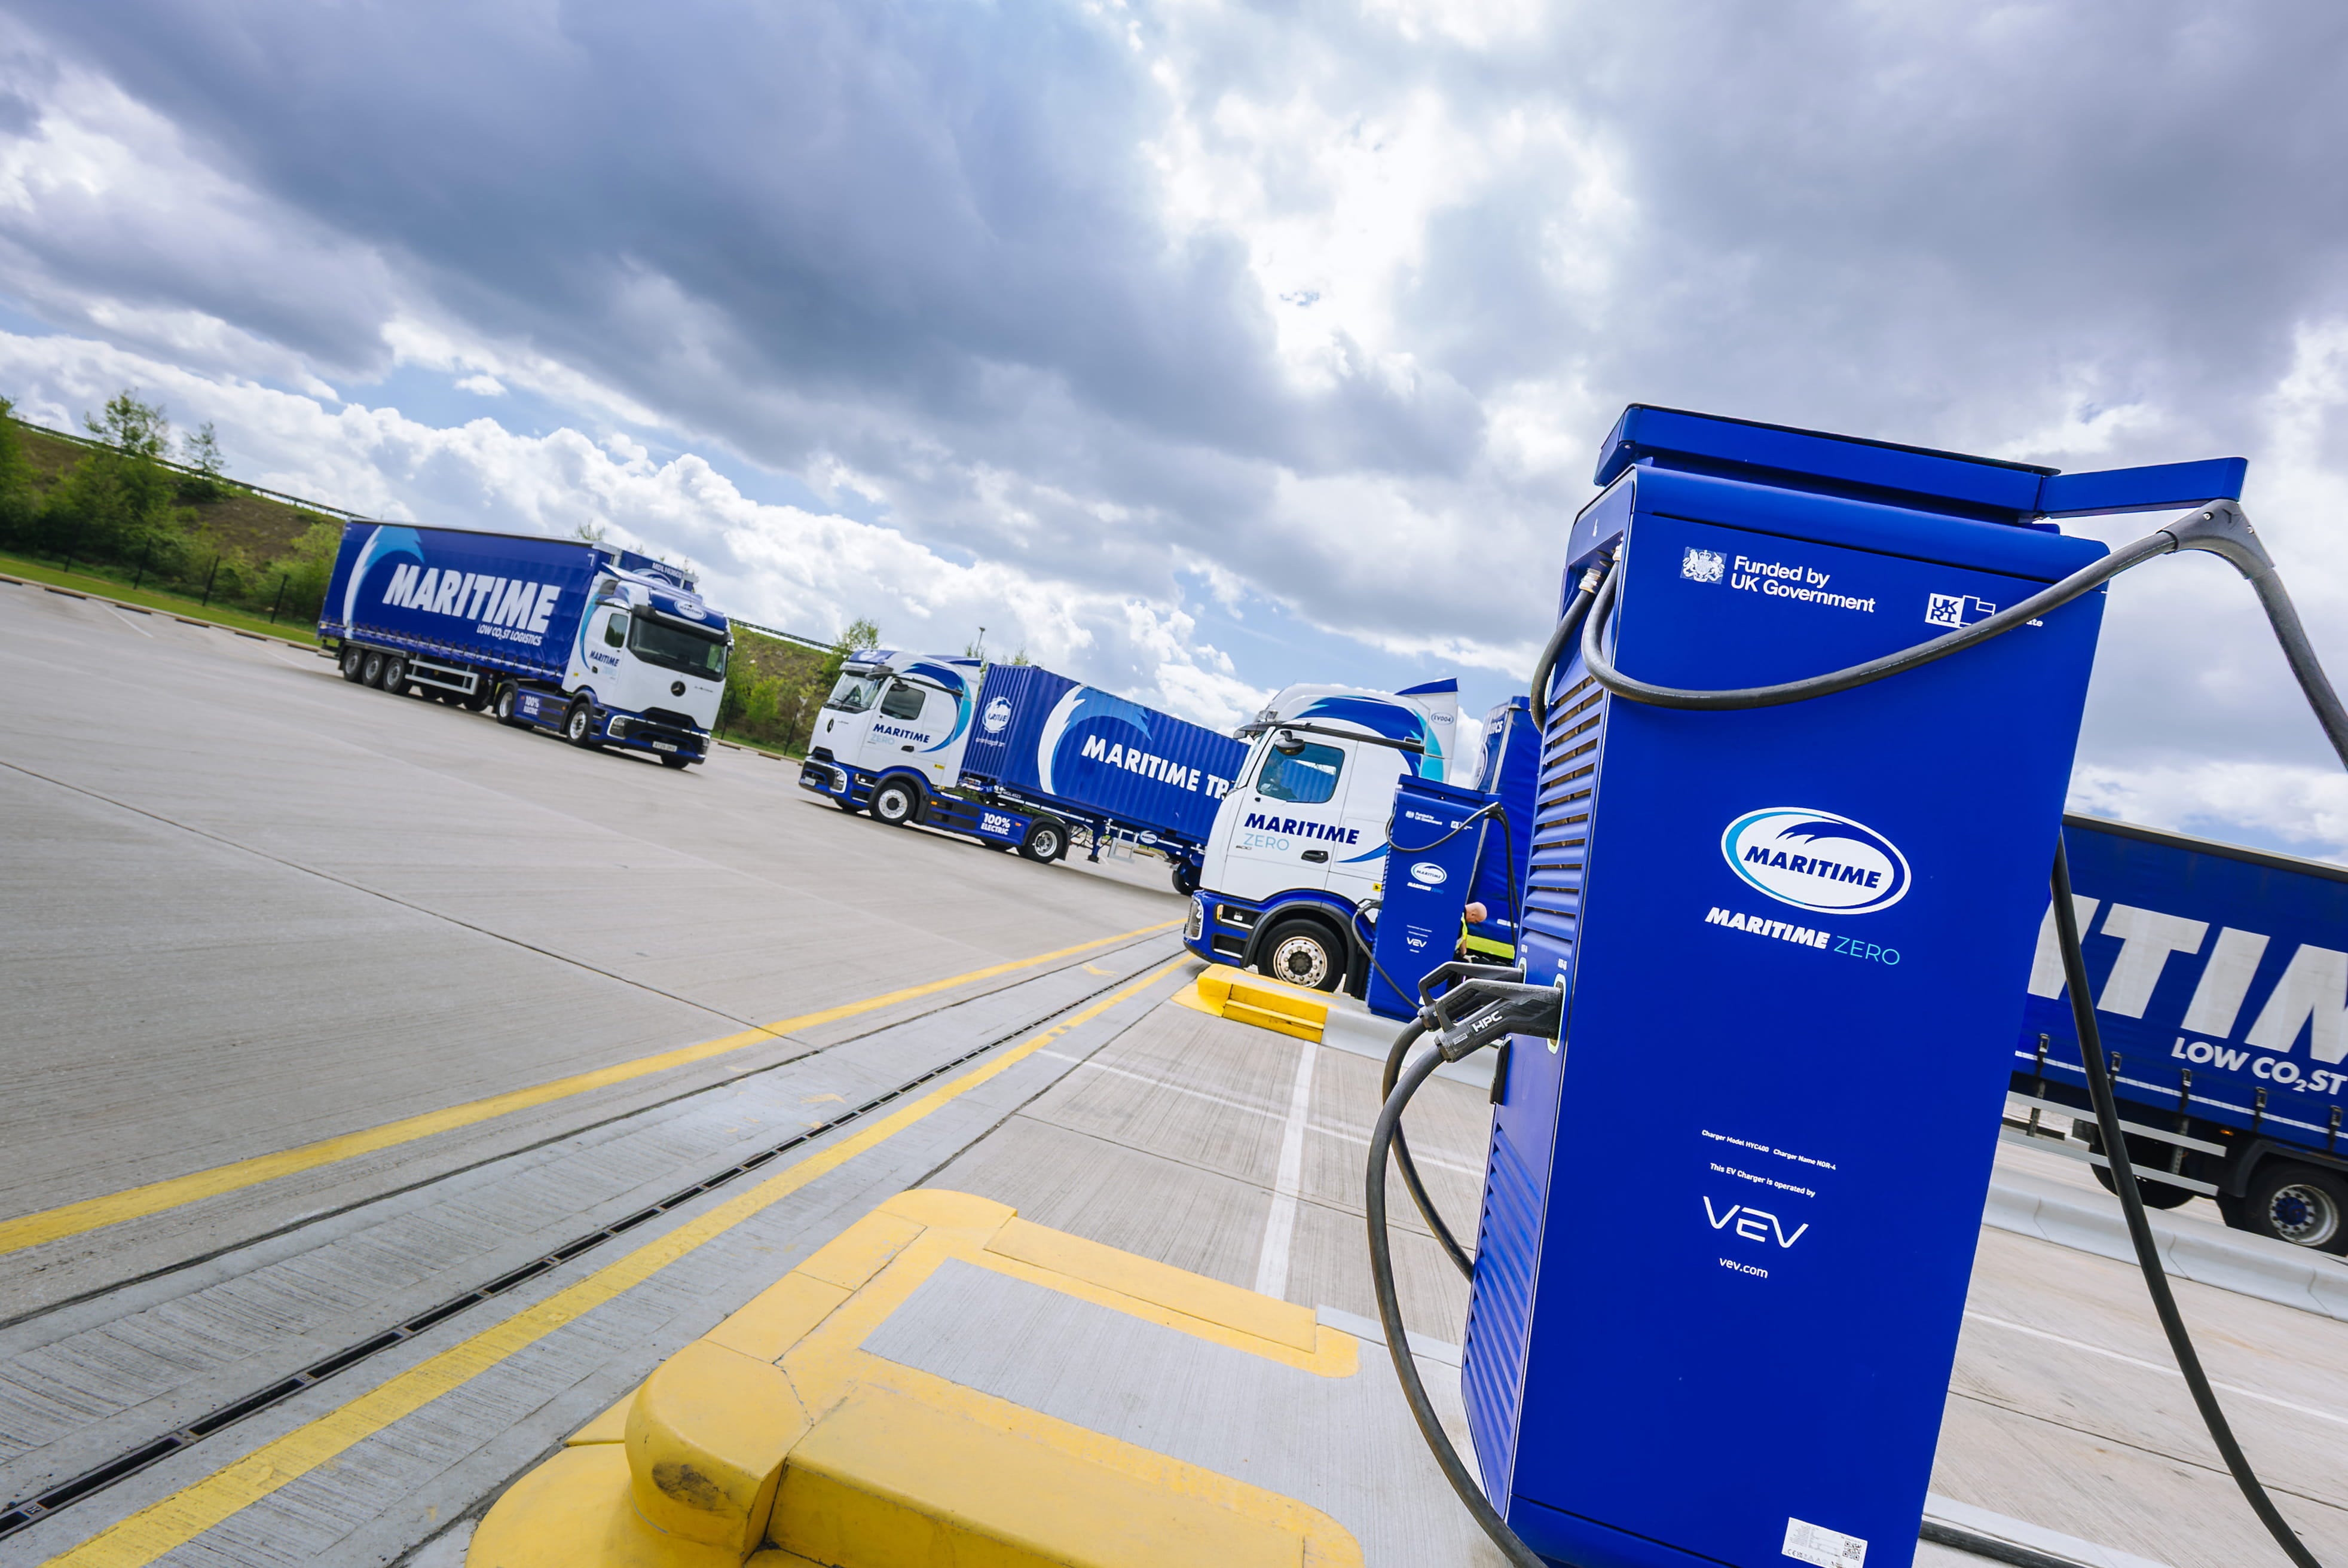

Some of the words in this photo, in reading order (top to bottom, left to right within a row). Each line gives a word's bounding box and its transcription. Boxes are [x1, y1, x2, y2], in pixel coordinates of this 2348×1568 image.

[1734, 555, 1803, 580] Funded
[1806, 568, 1830, 588] by
[382, 563, 561, 634] MARITIME
[1731, 573, 1760, 592] UK
[1763, 579, 1876, 613] Government
[476, 624, 491, 635] LOW
[509, 631, 542, 646] LOGISTICS
[589, 650, 619, 667] MARITIME
[525, 696, 539, 708] 100%
[870, 733, 895, 745] ZERO
[873, 723, 930, 743] MARITIME
[1081, 735, 1201, 791] MARITIME
[980, 823, 1009, 835] ELECTRIC
[984, 812, 1010, 828] 100%
[1244, 812, 1360, 845] MARITIME
[1243, 833, 1289, 851] ZERO
[1743, 845, 1882, 889] MARITIME
[1407, 937, 1427, 947] VEV
[1704, 906, 1831, 949] MARITIME
[1833, 935, 1900, 965] ZERO
[1472, 1010, 1503, 1032] HPC
[2171, 1037, 2250, 1071] LOW
[1702, 1129, 1726, 1141] Charger
[1726, 1136, 1744, 1146] Model
[1745, 1141, 1769, 1153] HYC400
[1773, 1148, 1797, 1160] Charger
[1798, 1155, 1816, 1165] Name
[1710, 1162, 1725, 1172] This
[1726, 1167, 1736, 1175] EV
[1737, 1170, 1766, 1183] Charger
[1774, 1181, 1805, 1194] operated
[1806, 1188, 1815, 1198] by
[1703, 1196, 1809, 1248] VEV
[1719, 1257, 1768, 1279] vev.com
